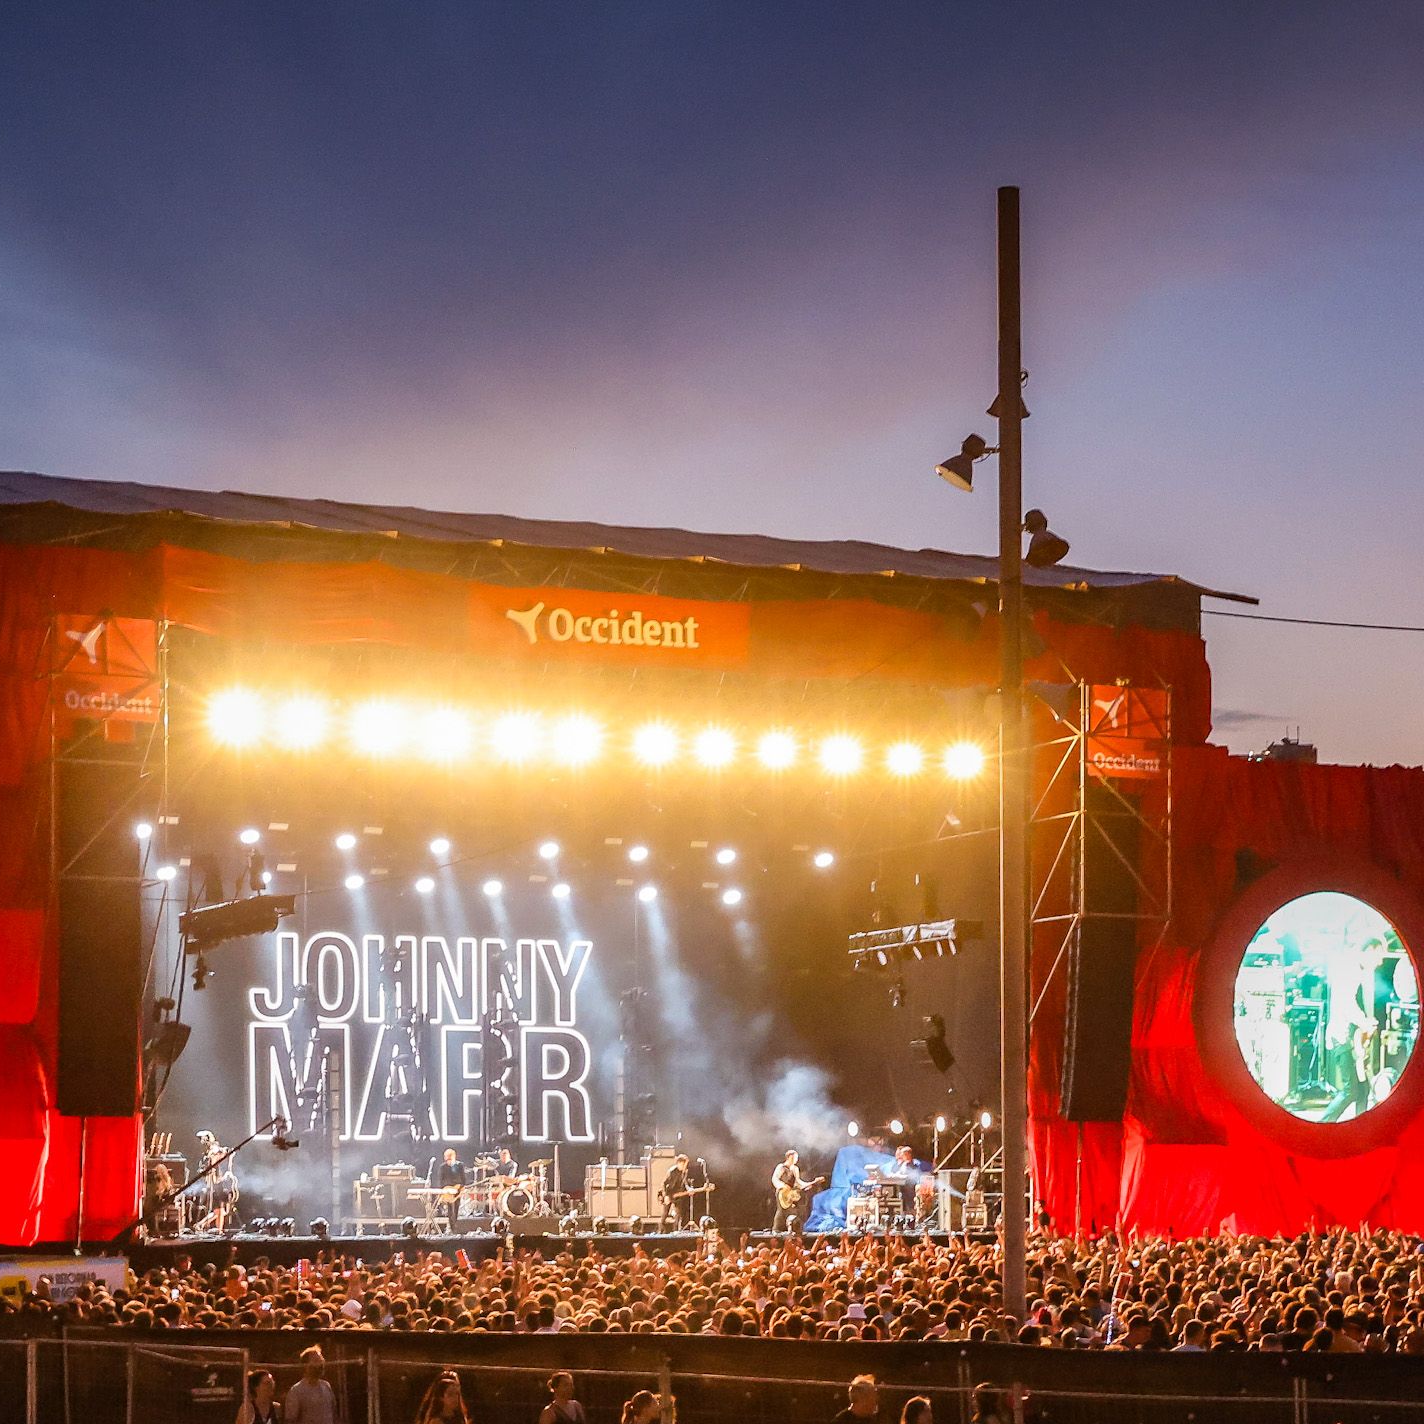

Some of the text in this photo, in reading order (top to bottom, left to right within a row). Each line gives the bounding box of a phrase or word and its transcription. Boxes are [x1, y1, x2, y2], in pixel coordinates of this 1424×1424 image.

[548, 607, 700, 649] Occident
[64, 689, 154, 715] Occident
[1093, 751, 1161, 773] Occident
[248, 931, 594, 1027] JOHNNY
